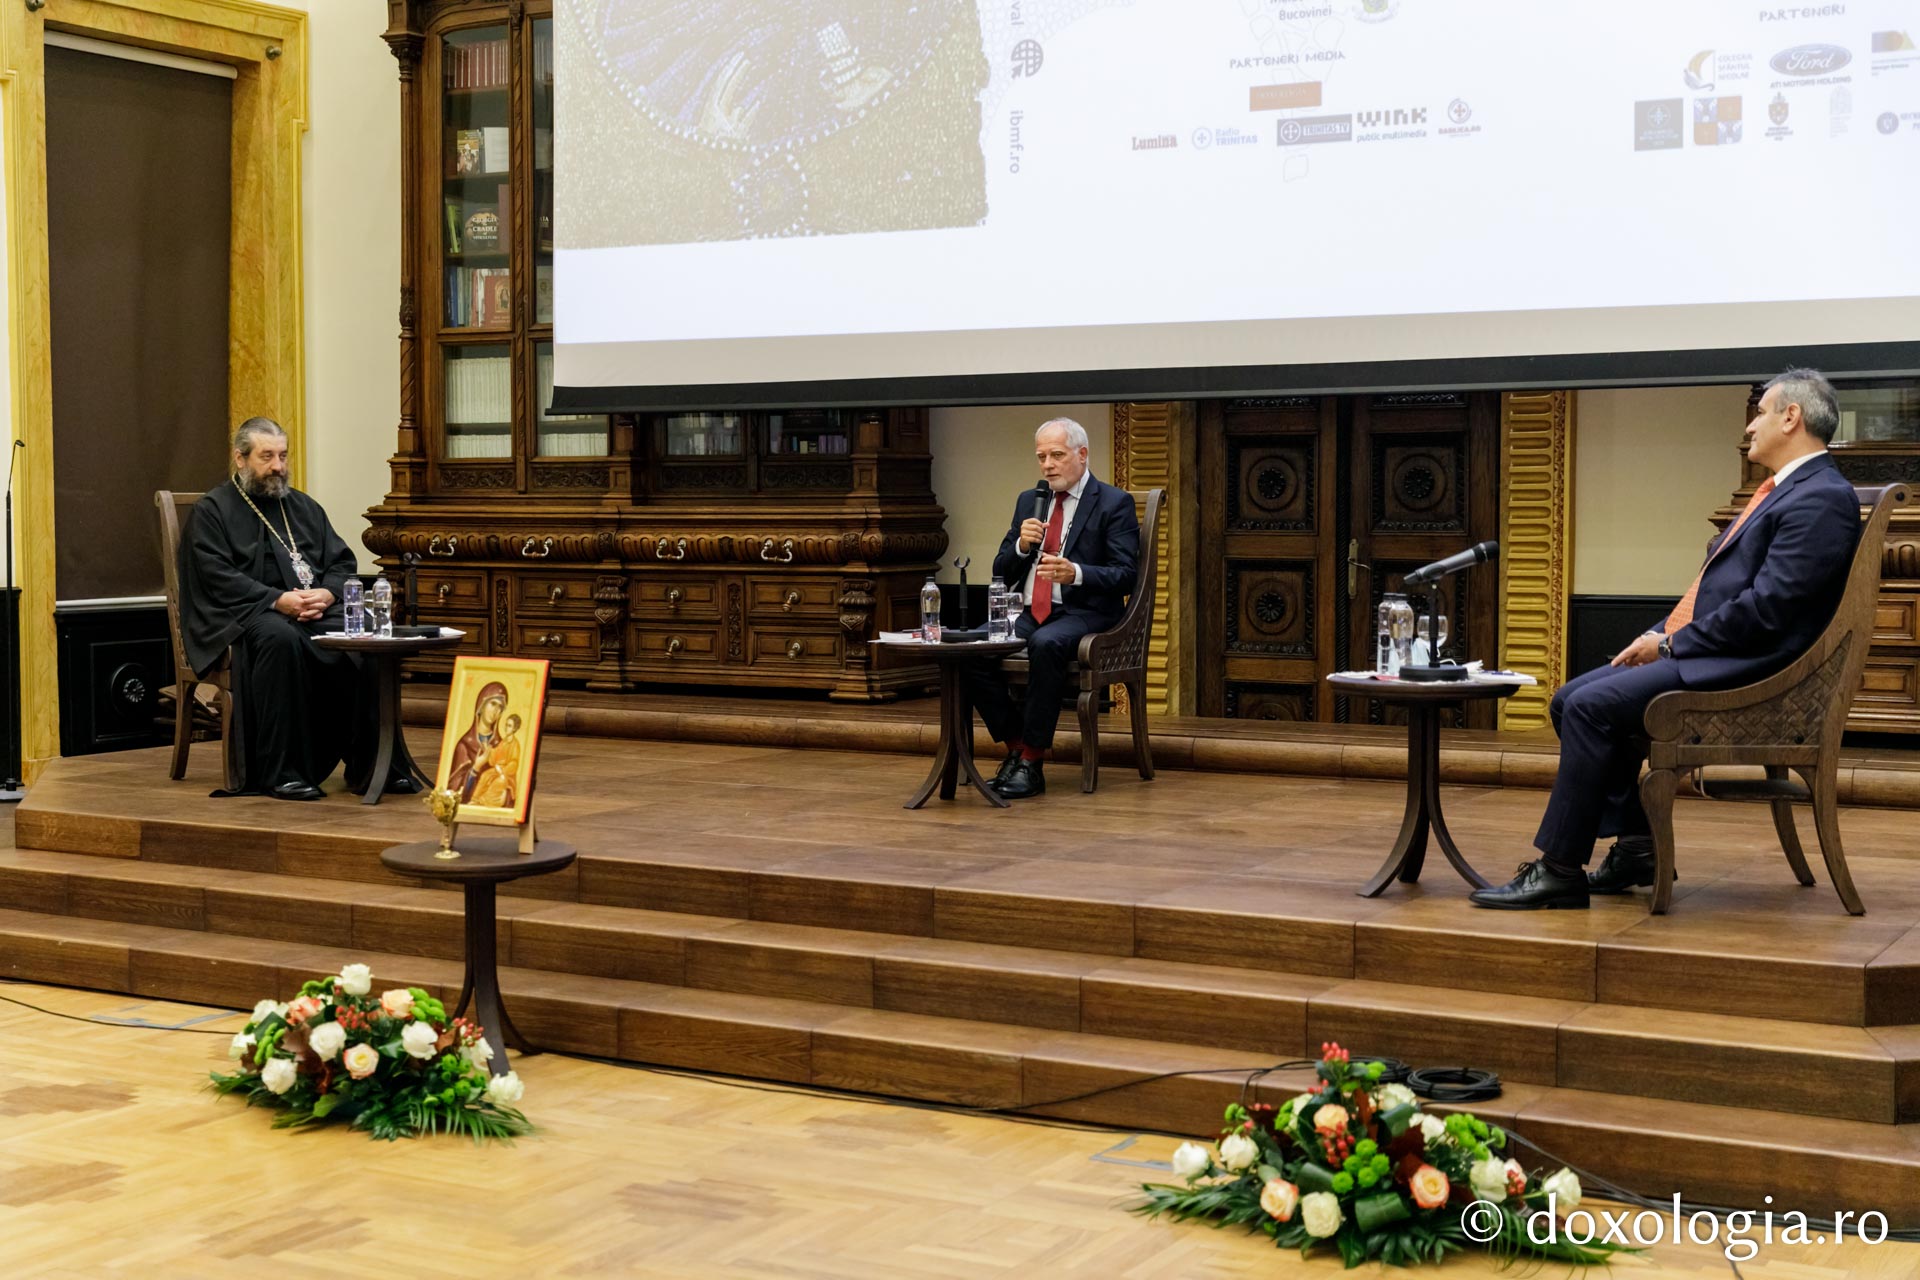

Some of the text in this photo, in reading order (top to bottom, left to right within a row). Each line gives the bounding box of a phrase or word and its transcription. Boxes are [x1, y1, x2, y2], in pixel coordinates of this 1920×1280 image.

[1279, 4, 1332, 21] Bucovinei
[1759, 4, 1845, 22] PARTENERI
[1229, 50, 1346, 69] PARTENERI MEDIA
[1786, 49, 1835, 70] Ford
[1215, 127, 1240, 138] Radio
[1215, 134, 1258, 146] TRINITAS
[1356, 128, 1428, 143] public multimedia
[1009, 110, 1024, 174] ibmf.ro
[1131, 134, 1178, 151] Lumina
